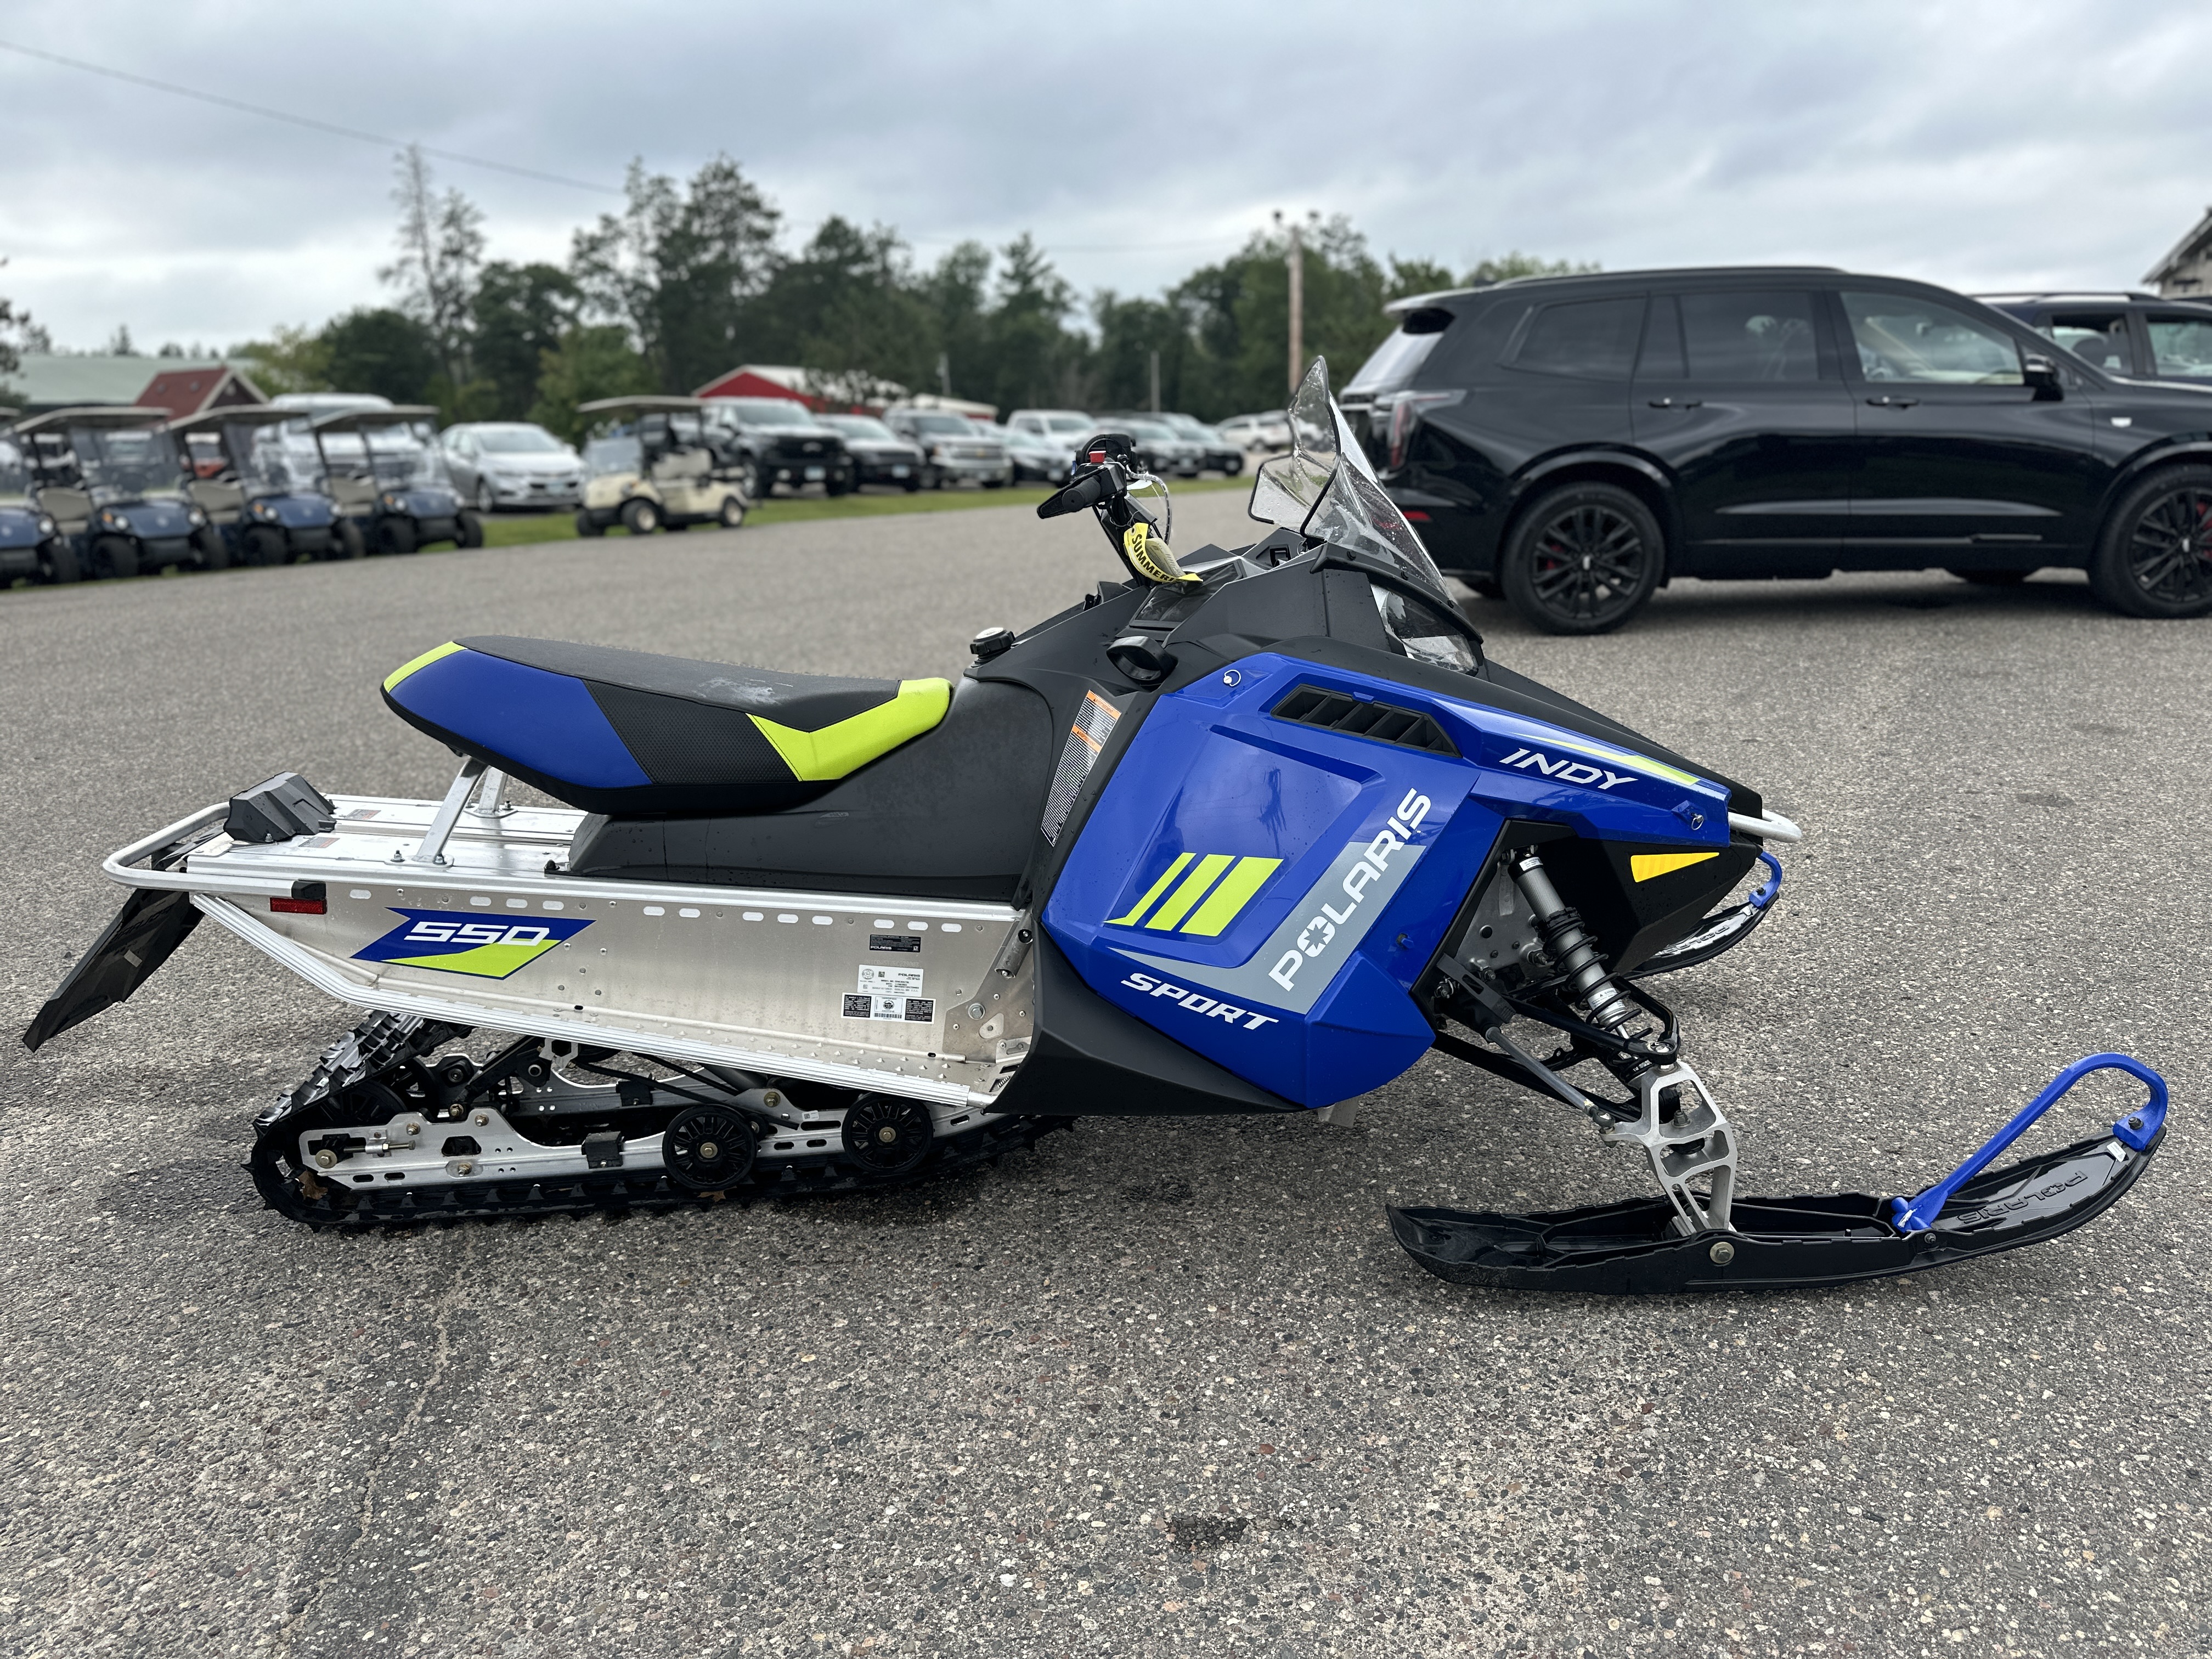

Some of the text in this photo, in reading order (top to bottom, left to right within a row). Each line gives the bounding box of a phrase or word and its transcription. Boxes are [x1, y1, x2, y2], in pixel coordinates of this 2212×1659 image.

[1132, 534, 1178, 582] SUMMERI
[1499, 748, 1638, 790] INDY
[1268, 788, 1432, 992] POLARIS
[404, 922, 550, 946] 550
[1121, 973, 1279, 1030] SPORT
[1956, 1170, 2089, 1224] POLARIS
